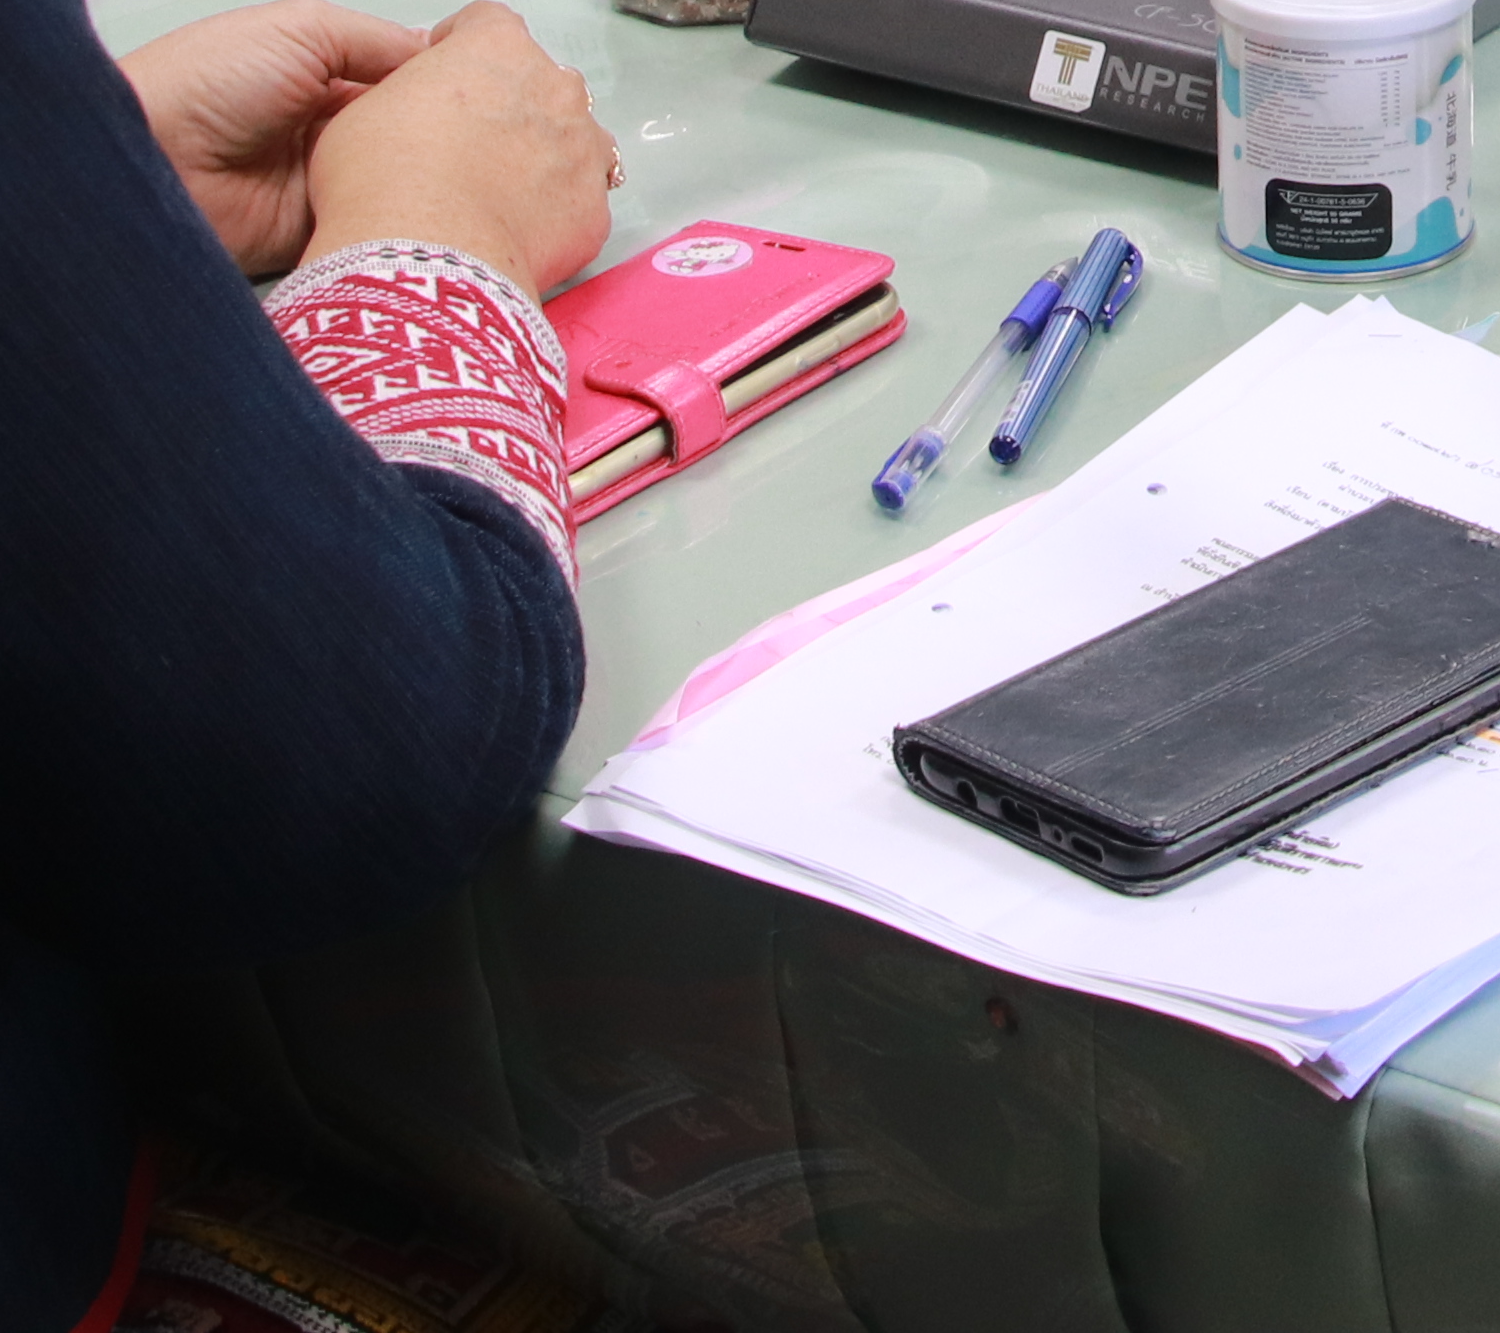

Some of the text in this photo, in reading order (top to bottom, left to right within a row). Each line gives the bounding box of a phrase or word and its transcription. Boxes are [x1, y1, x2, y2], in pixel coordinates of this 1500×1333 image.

[1036, 84, 1090, 103] THAILAND
[1103, 55, 1214, 110] NPE
[1100, 87, 1206, 123] RESEARCH
